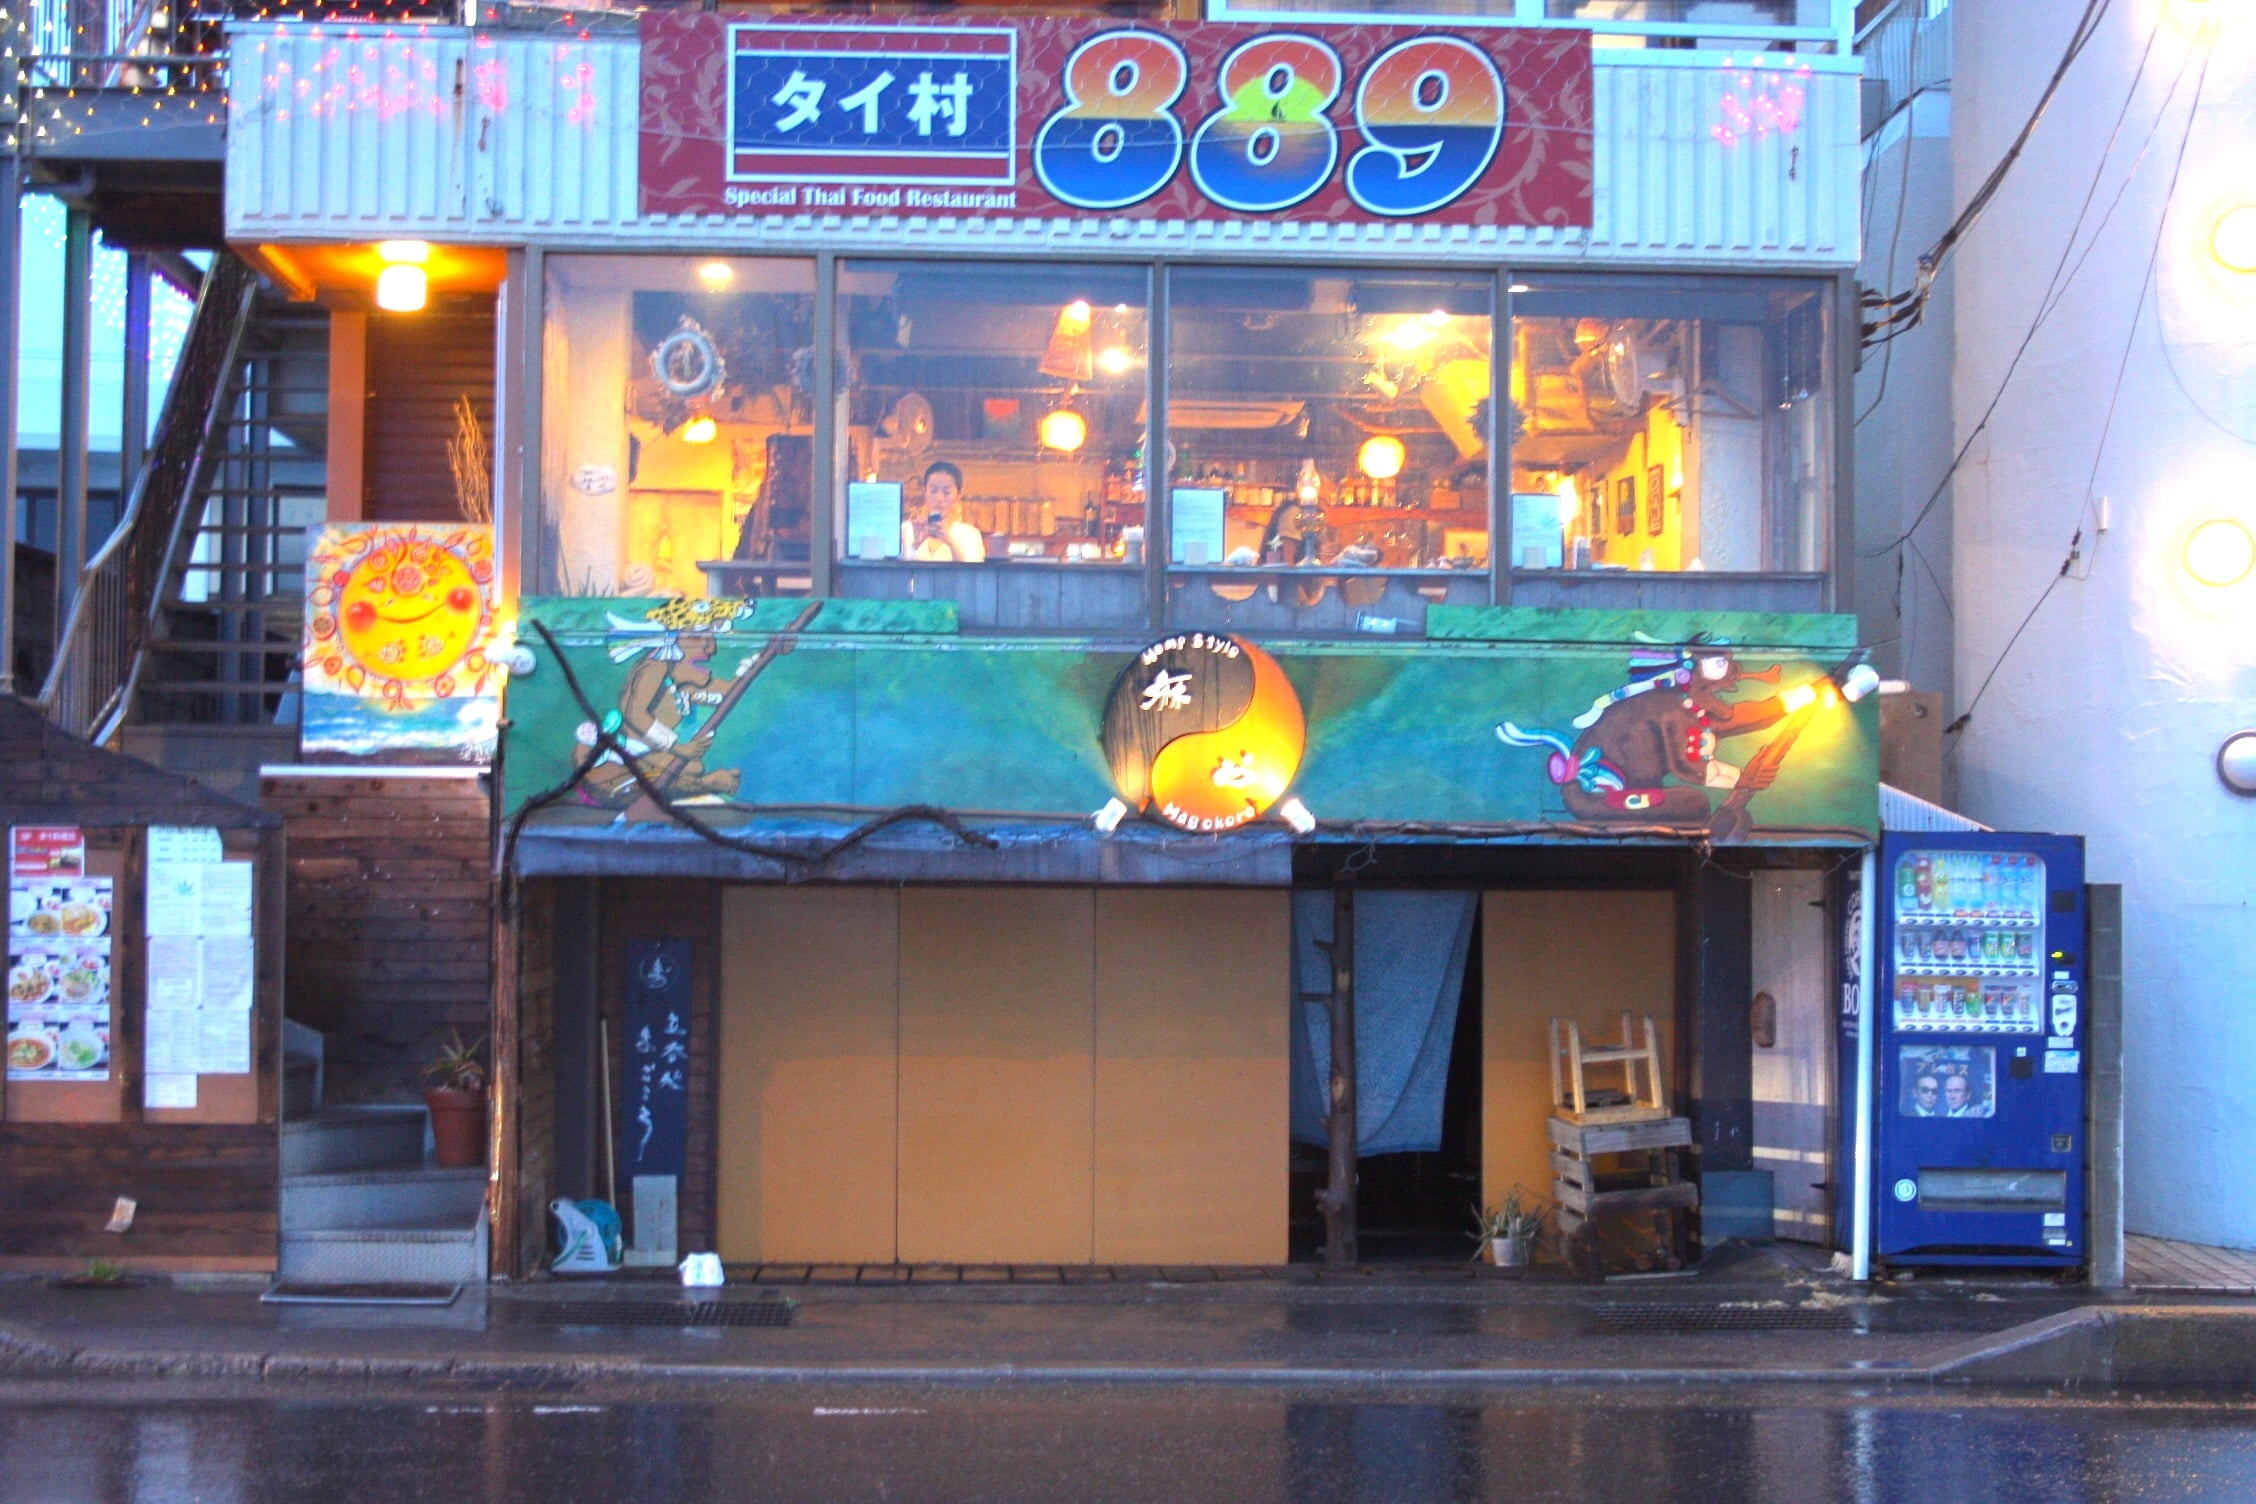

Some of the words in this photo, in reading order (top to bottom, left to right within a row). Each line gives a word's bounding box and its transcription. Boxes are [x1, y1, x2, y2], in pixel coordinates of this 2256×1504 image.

[771, 70, 973, 137] タイ村
[1033, 28, 1504, 217] 889
[725, 187, 796, 208] Special
[803, 188, 846, 206] Thai
[852, 188, 901, 207] Food
[906, 189, 1016, 209] Restaurant
[1191, 632, 1240, 659] Style
[1162, 801, 1255, 831] Magokoro
